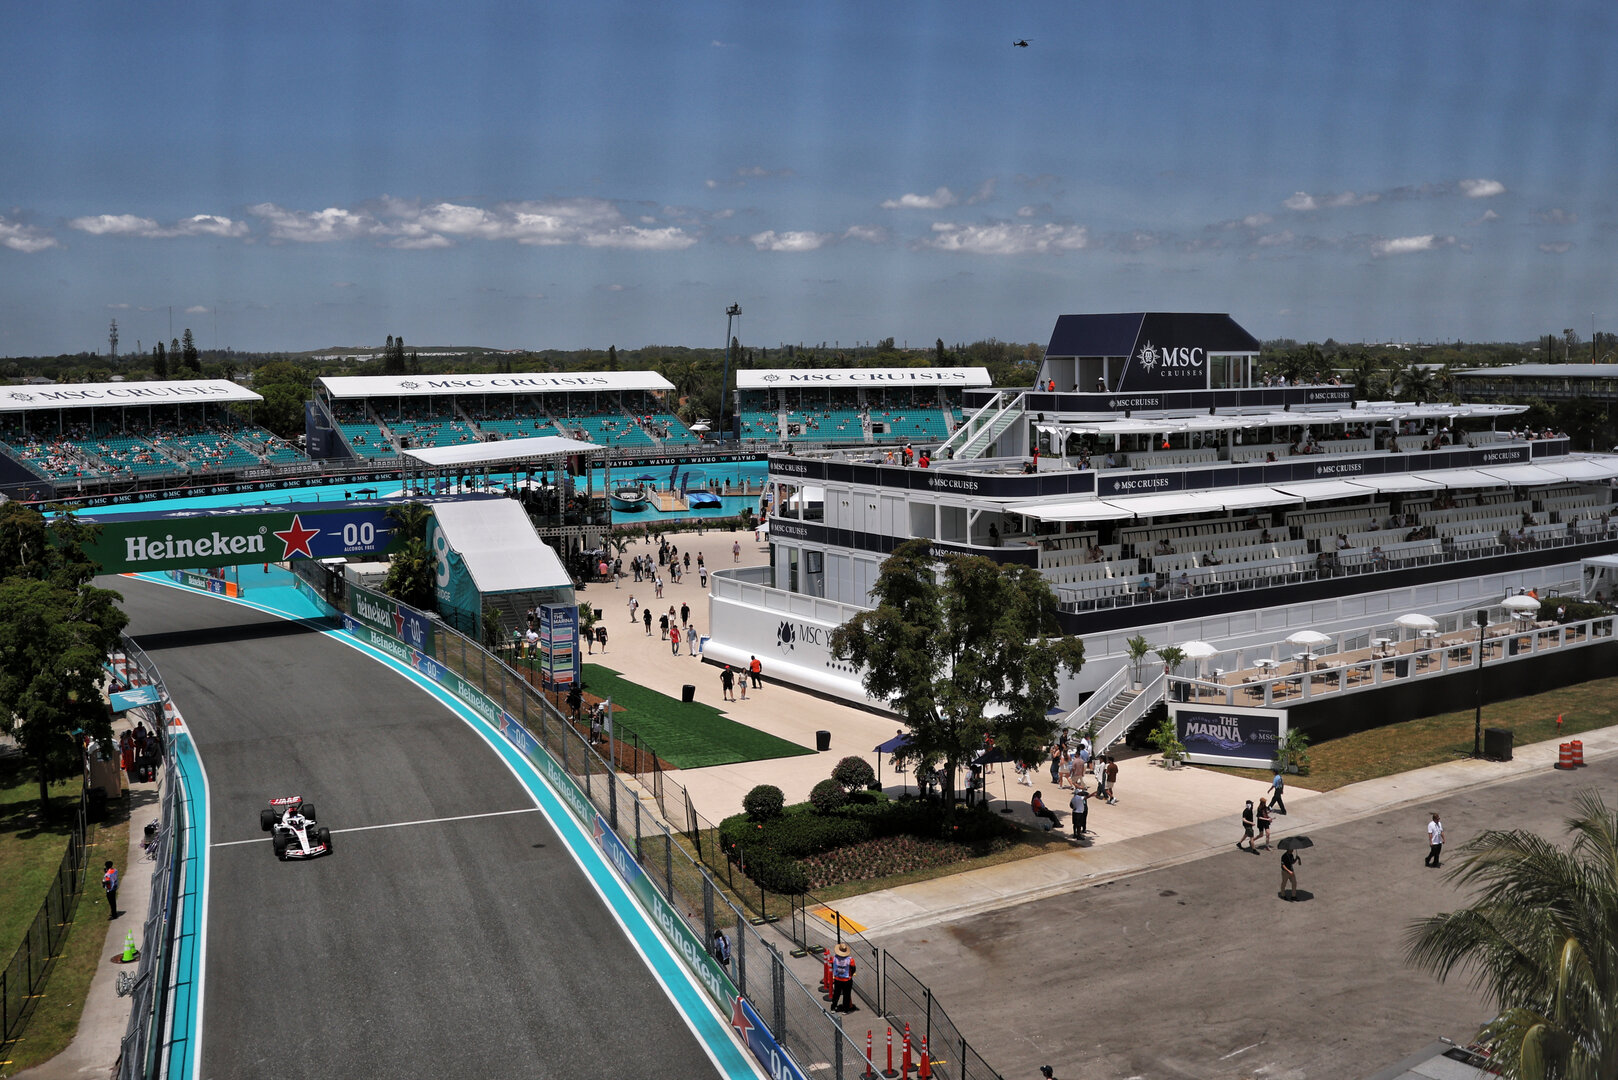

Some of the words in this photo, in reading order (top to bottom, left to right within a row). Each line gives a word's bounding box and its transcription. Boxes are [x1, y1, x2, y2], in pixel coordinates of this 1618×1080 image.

[1162, 348, 1202, 367] MSC
[428, 379, 484, 388] MSC
[491, 377, 608, 387] CRUISES
[790, 373, 842, 382] MSC
[850, 372, 966, 381] CRUISES
[38, 390, 104, 400] MSC
[107, 384, 229, 398] CRUISES
[1326, 392, 1350, 400] CRUISES
[1488, 453, 1498, 461] MSC
[1499, 452, 1520, 460] CRUISES
[785, 464, 807, 473] CRUISES
[1322, 465, 1336, 474] MSC
[1336, 464, 1362, 473] CRUISES
[934, 478, 948, 487] MSC
[948, 480, 978, 490] CRUISES
[1121, 480, 1137, 489] MSC
[1137, 478, 1169, 488] CRUISES
[344, 522, 374, 546] 0.0
[774, 524, 786, 533] MSC
[786, 526, 808, 535] CRUISES
[800, 624, 822, 645] MSC
[1219, 716, 1239, 726] THE
[1185, 722, 1242, 742] MARINA
